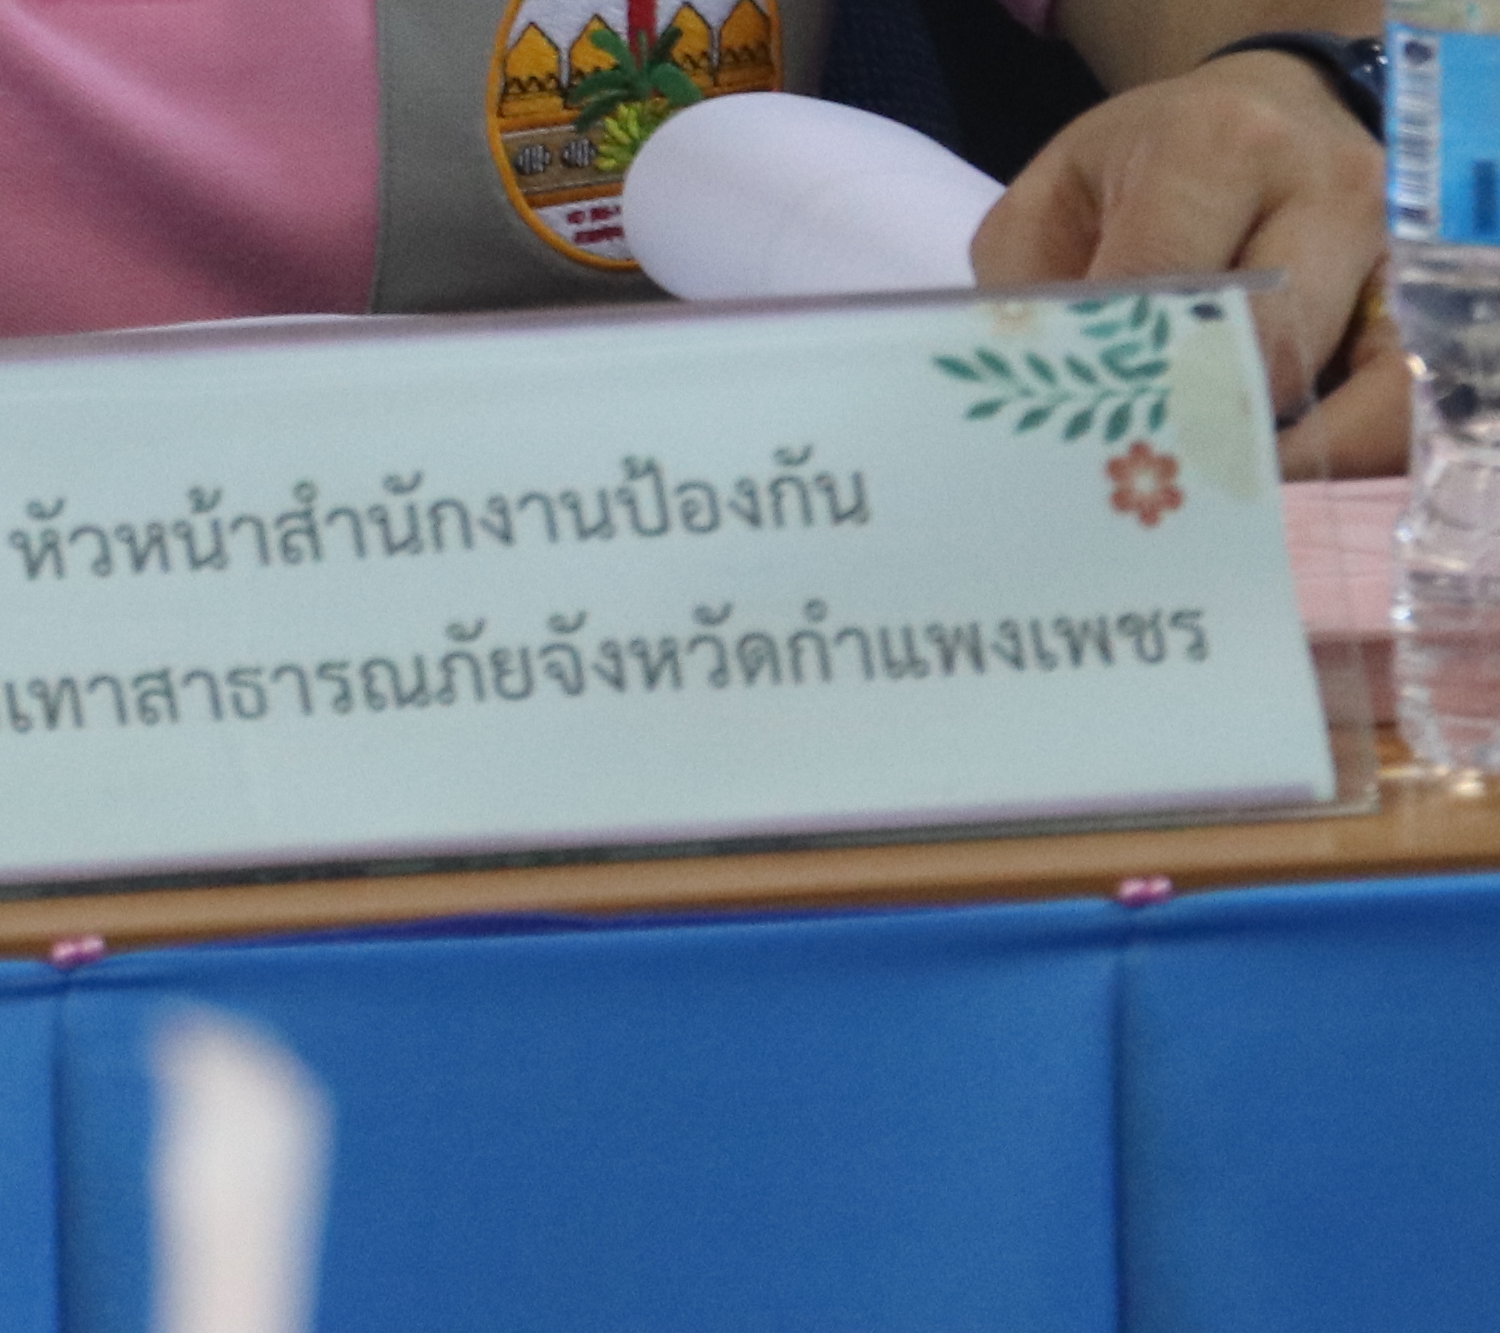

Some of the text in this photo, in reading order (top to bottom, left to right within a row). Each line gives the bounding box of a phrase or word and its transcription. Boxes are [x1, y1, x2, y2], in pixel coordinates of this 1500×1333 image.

[6, 443, 872, 582] หัวหน้าสำนักงานป้องกัน
